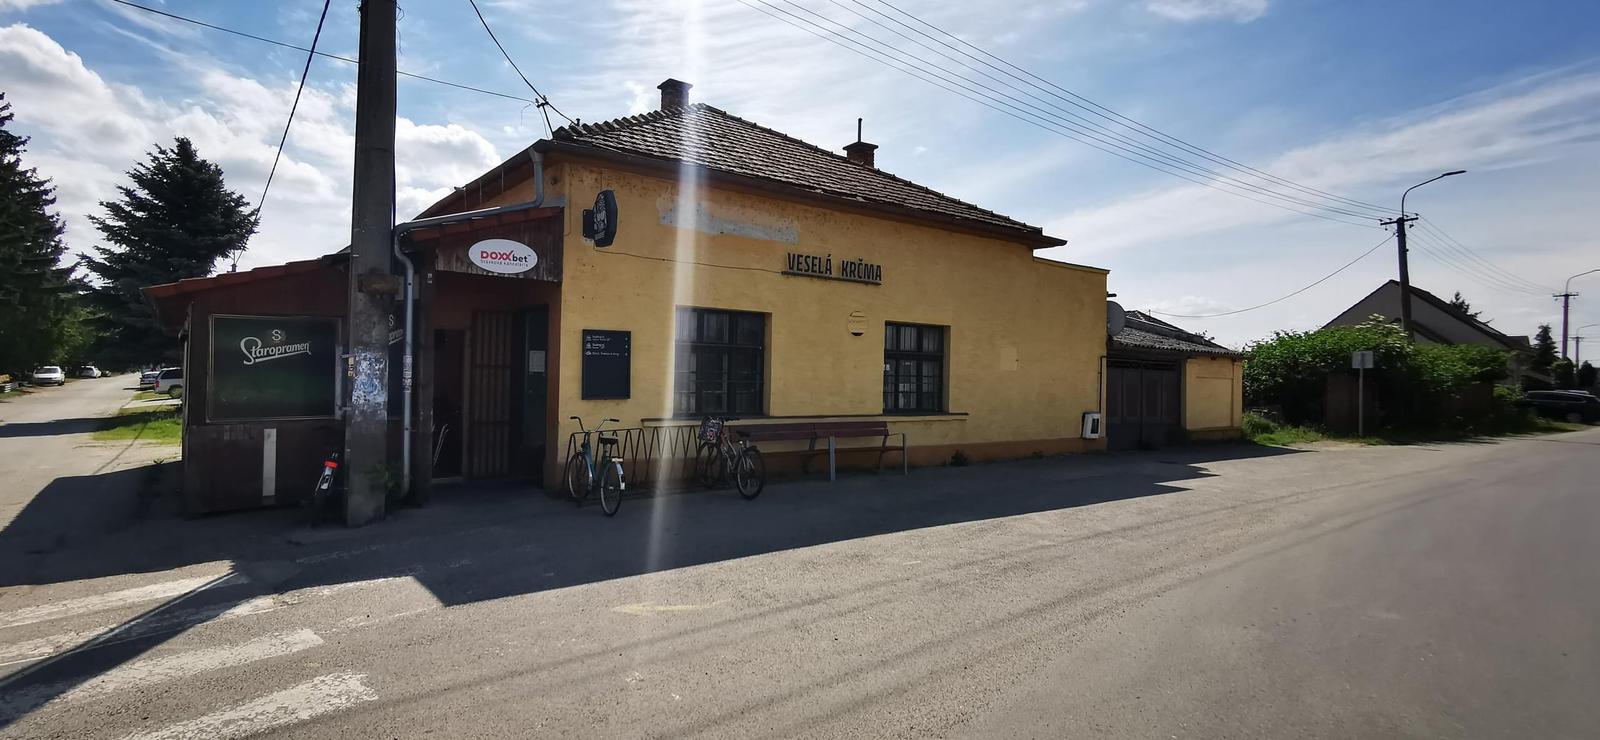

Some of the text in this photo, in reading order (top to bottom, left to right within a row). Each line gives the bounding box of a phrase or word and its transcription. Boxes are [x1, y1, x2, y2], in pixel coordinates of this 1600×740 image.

[787, 252, 882, 281] VESELÁ KRČMA
[272, 329, 282, 341] S
[240, 336, 312, 365] Staropramen
